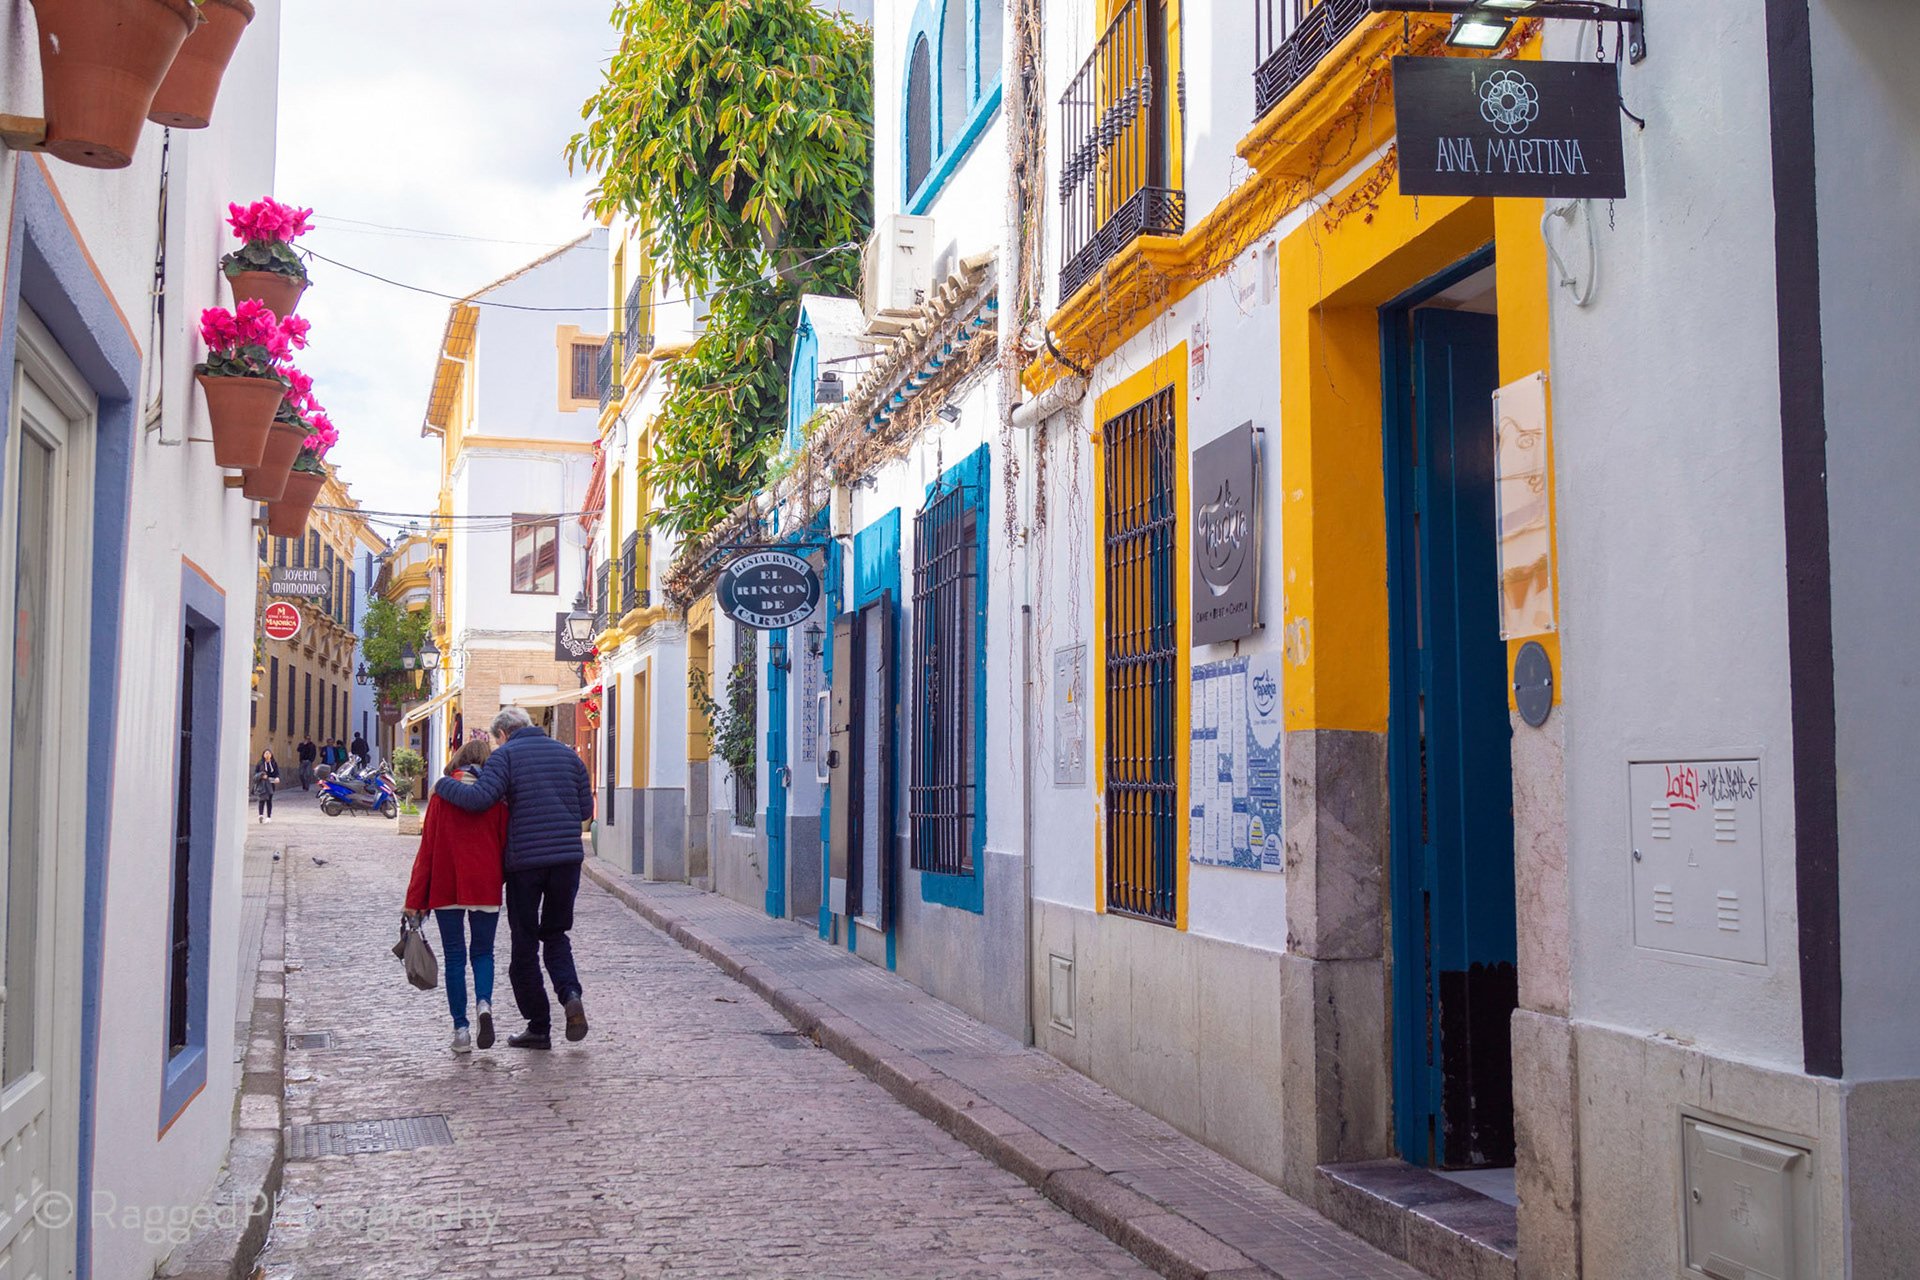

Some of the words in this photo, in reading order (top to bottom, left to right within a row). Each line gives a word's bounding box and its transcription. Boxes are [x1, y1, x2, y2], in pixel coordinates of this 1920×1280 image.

[1436, 137, 1480, 172] ANA
[1485, 138, 1590, 175] MARTINA
[734, 554, 807, 576] RESTAURANTE
[283, 569, 317, 581] JOYERIA
[760, 570, 782, 580] EL
[272, 582, 327, 594] MAIMONIDES
[737, 584, 807, 596] RINCON
[761, 600, 785, 610] DE
[738, 603, 809, 626] CARMEN
[805, 640, 813, 759] STAURANTE
